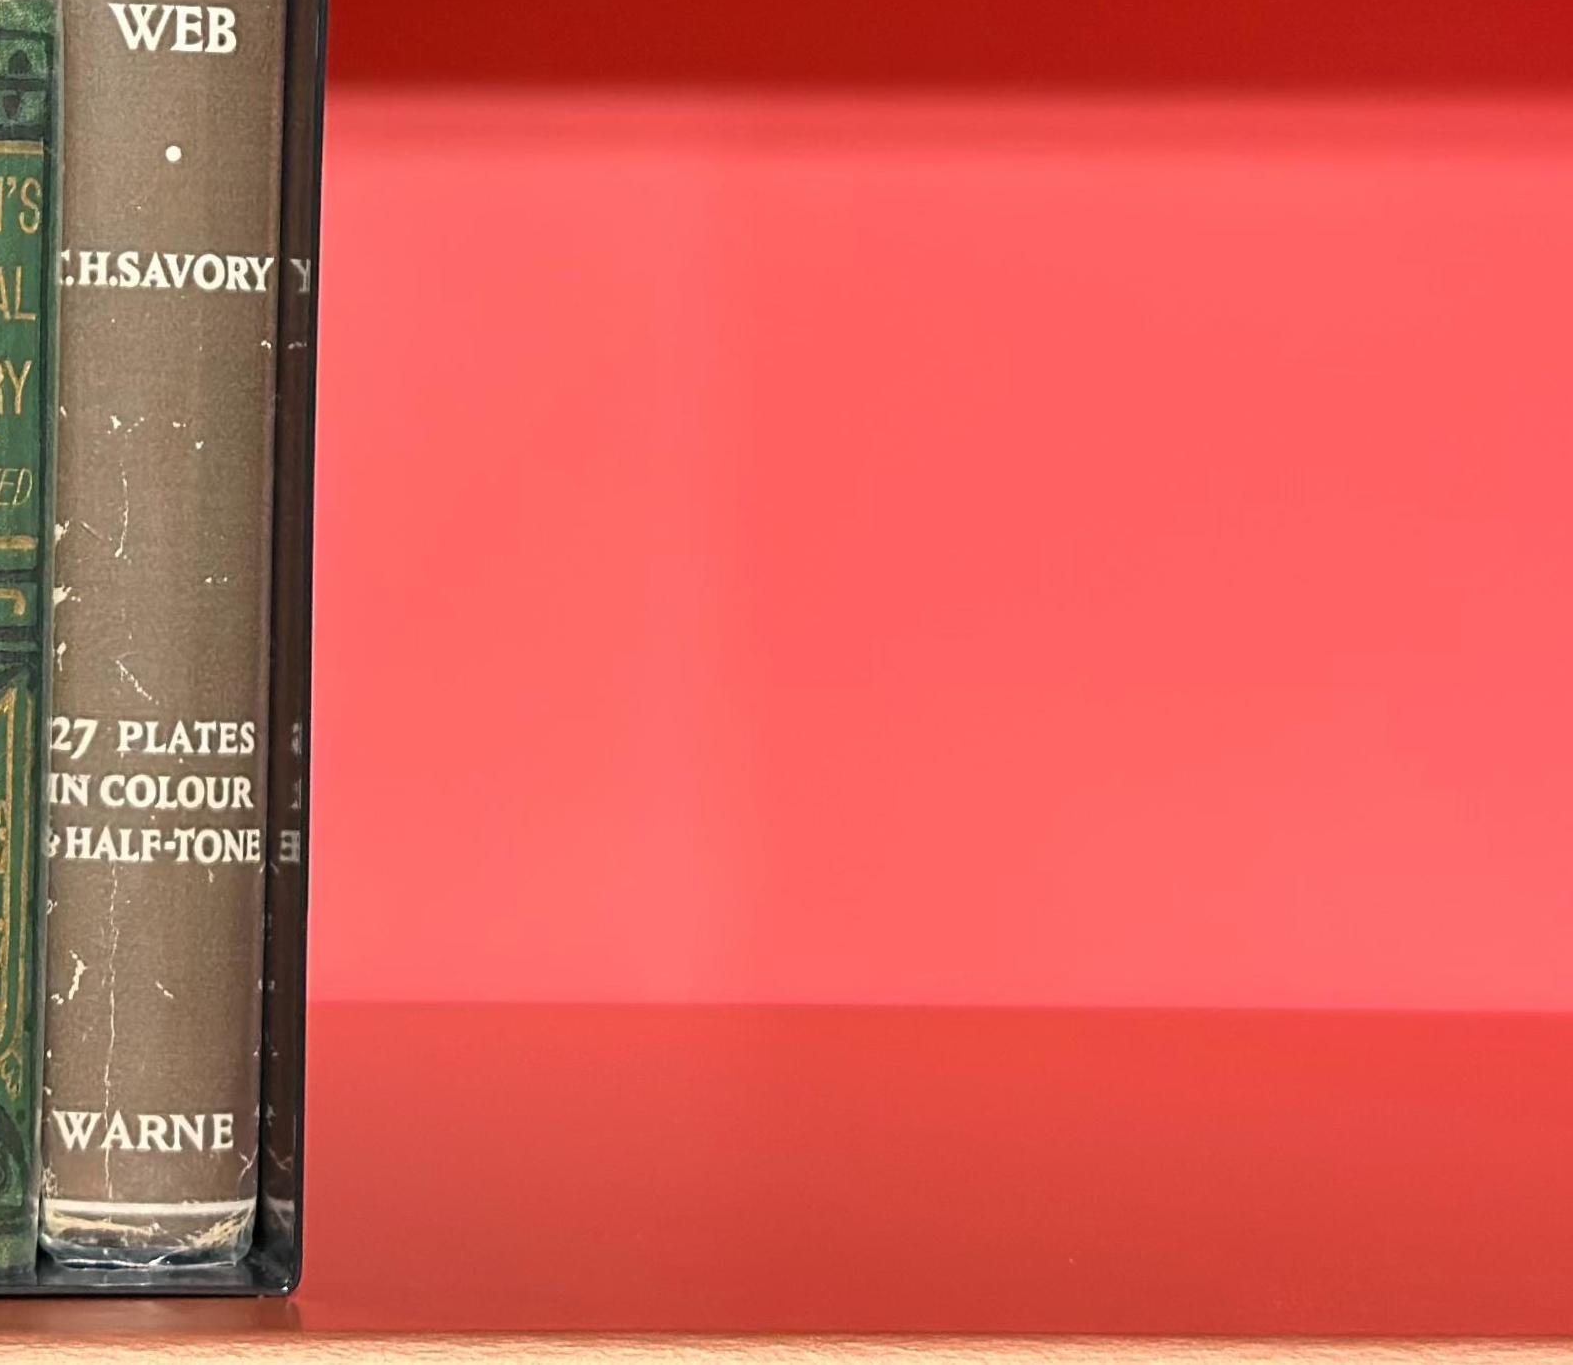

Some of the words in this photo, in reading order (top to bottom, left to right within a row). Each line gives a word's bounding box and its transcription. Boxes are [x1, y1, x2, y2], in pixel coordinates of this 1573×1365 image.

[107, 2, 238, 54] WEB
[51, 715, 99, 760] 27
[116, 719, 256, 755] PLATES
[50, 772, 91, 807] IN
[99, 773, 255, 810] COLOUR
[64, 825, 262, 864] HALF-TONE
[53, 1110, 235, 1152] WARNE
